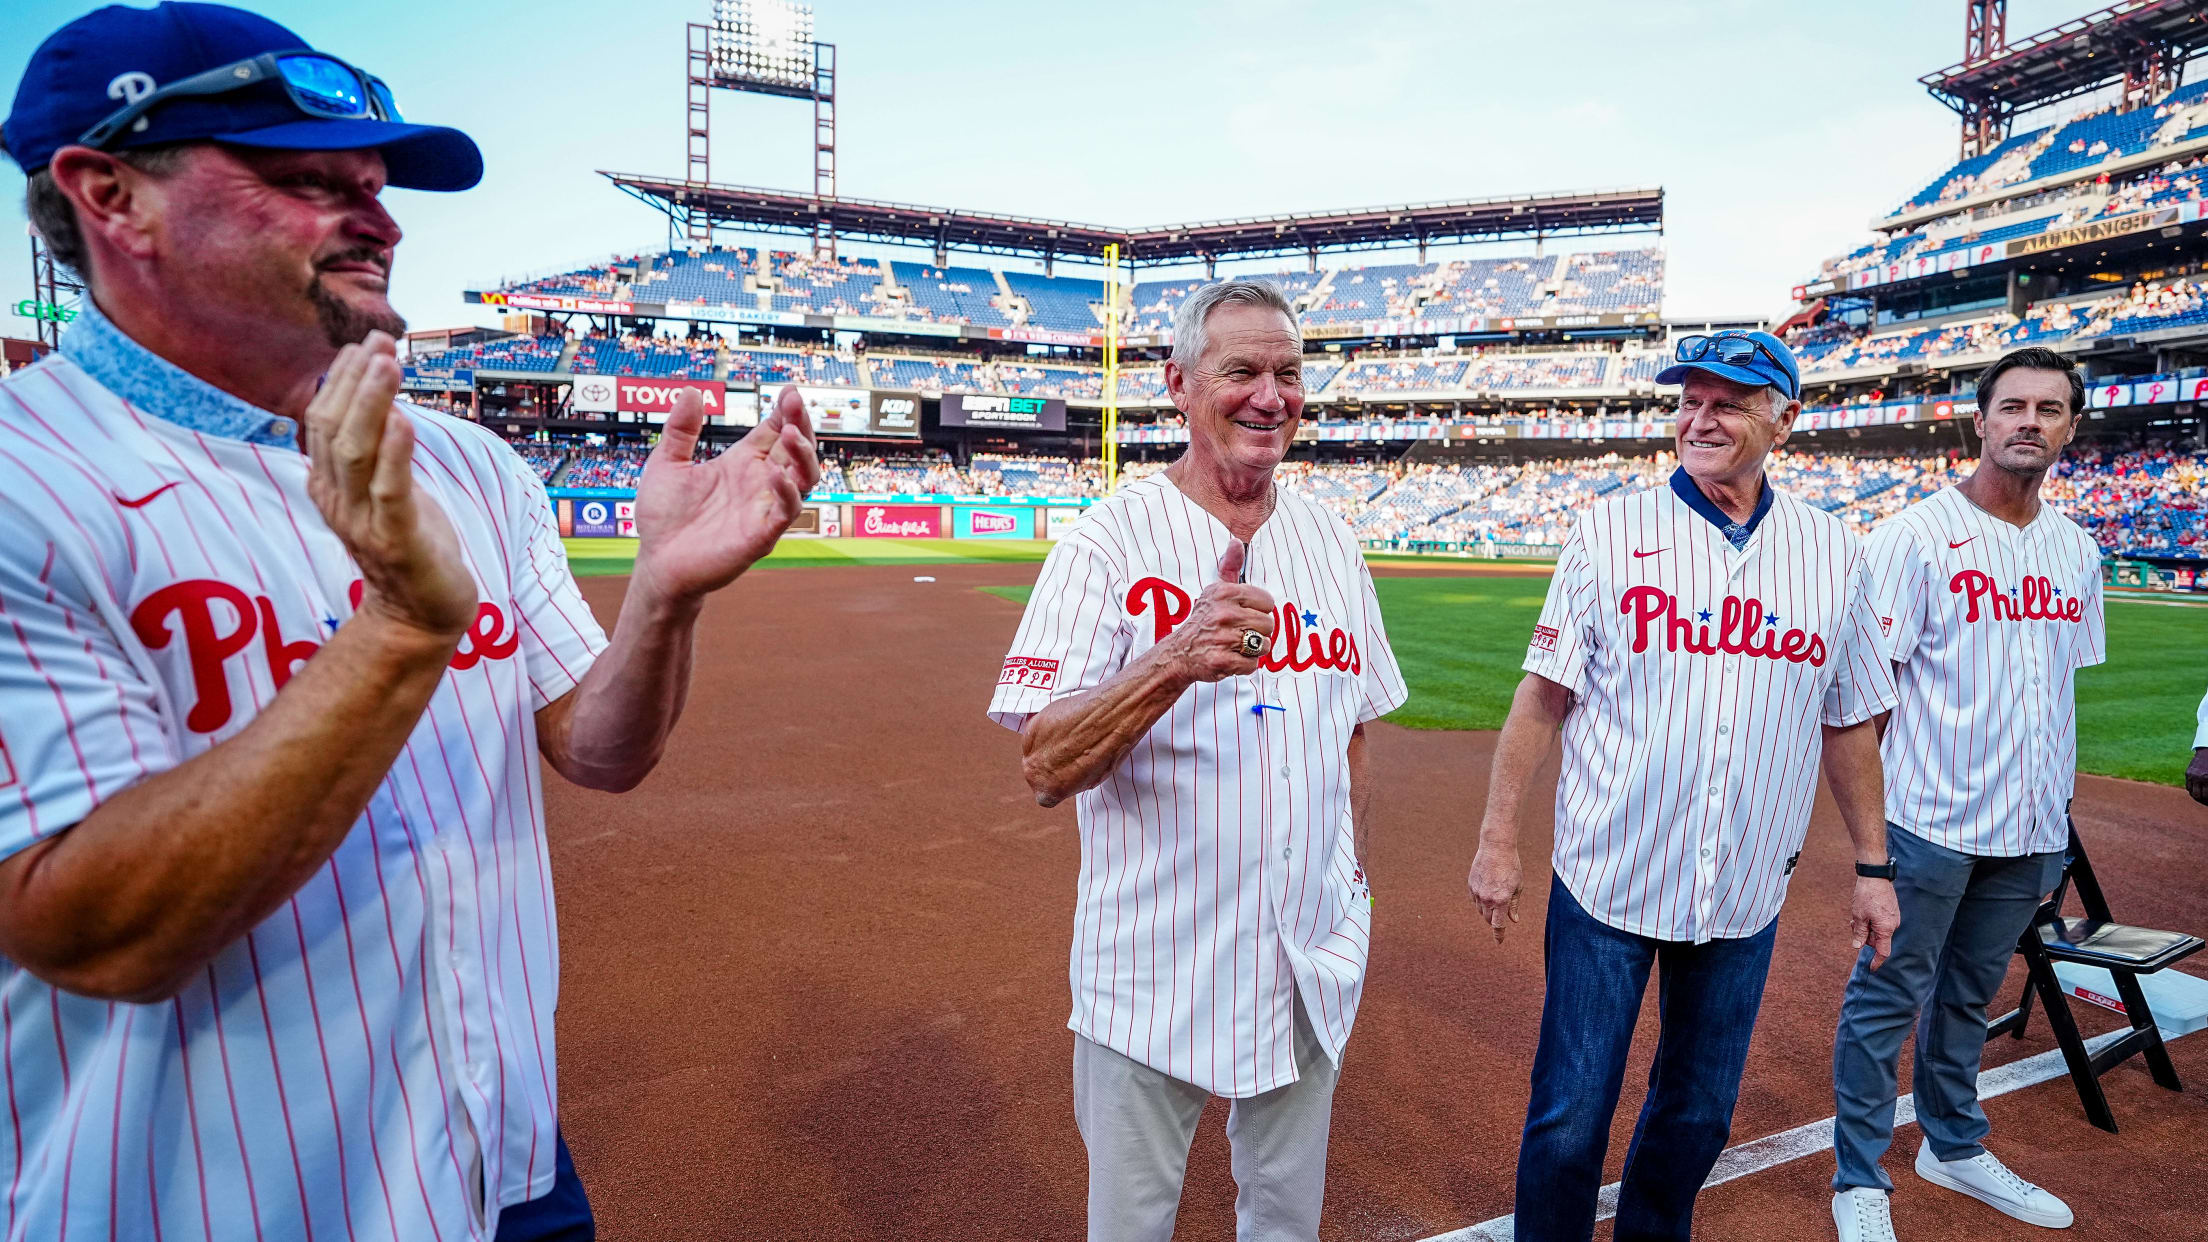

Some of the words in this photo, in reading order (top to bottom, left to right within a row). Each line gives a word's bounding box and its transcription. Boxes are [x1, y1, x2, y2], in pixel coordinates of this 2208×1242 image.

[2022, 228, 2094, 253] ALUMNI
[2096, 214, 2156, 238] NIGHT
[690, 307, 736, 320] LISCIO'S
[739, 310, 781, 322] BAKERY
[1514, 318, 1544, 327] TOYOTA
[621, 385, 717, 408] TOYOA
[1010, 398, 1047, 414] BET
[972, 411, 1037, 423] SPORTSBOOK
[1476, 427, 1506, 437] TOYOTA
[1950, 569, 2084, 623] Phillie
[1620, 585, 1827, 667] Phillies
[1029, 660, 1057, 669] ALUMNI
